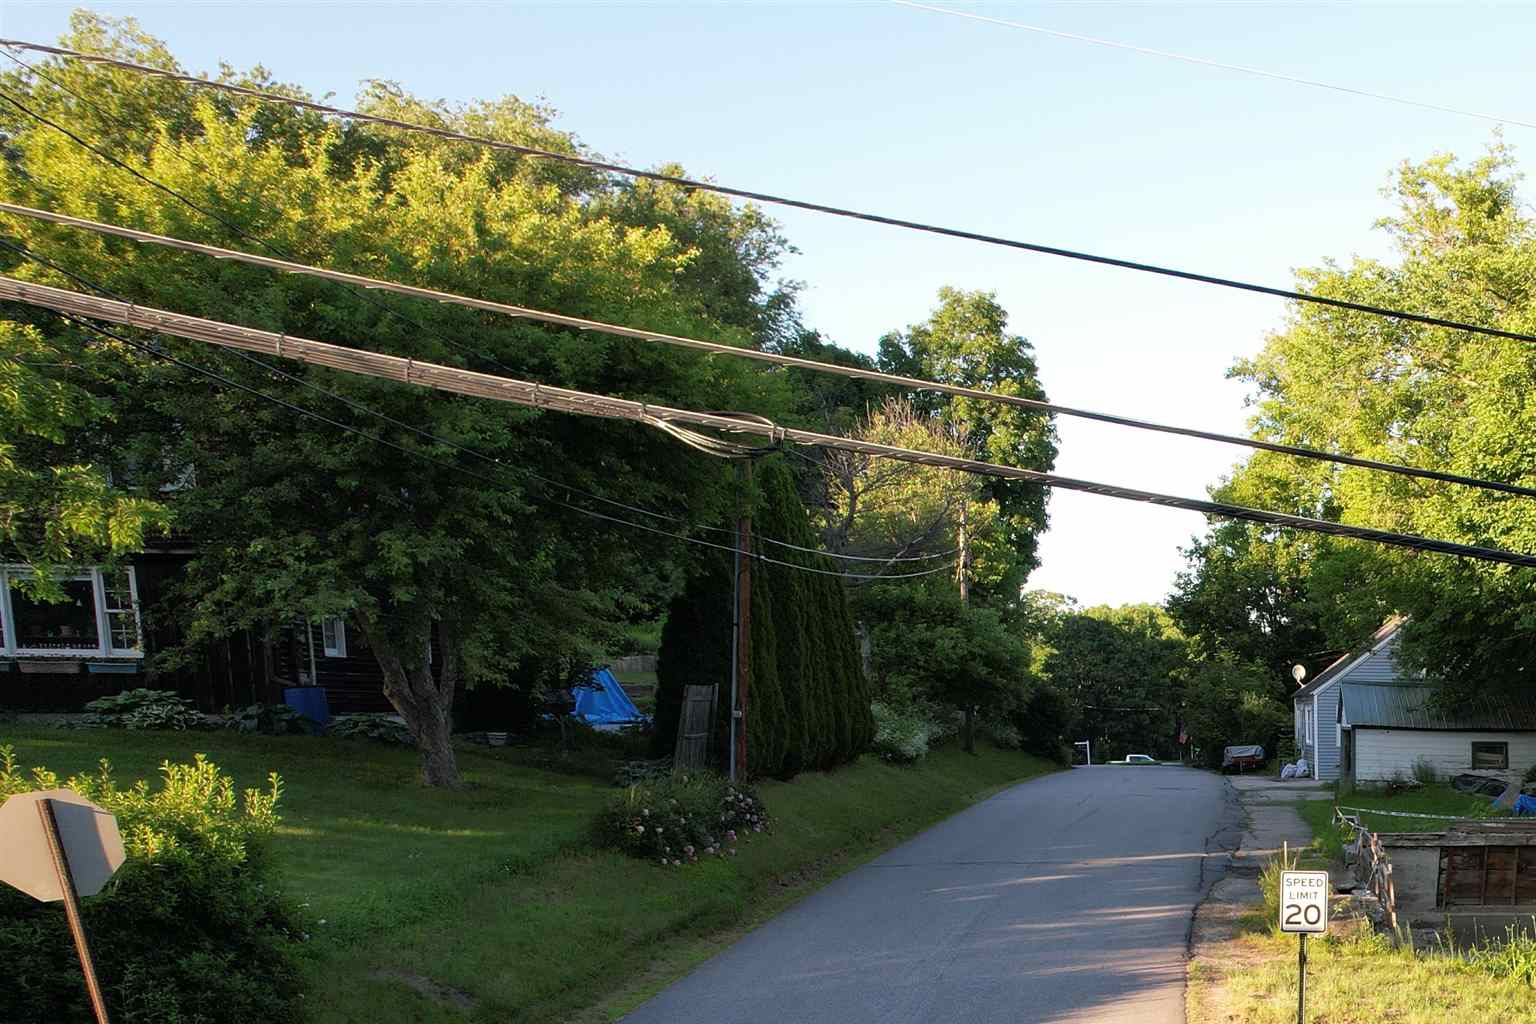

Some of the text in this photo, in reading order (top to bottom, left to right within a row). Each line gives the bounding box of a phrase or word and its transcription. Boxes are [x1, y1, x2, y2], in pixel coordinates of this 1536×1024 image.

[1286, 878, 1324, 887] SPEED
[1289, 891, 1319, 900] LIMIT
[1285, 904, 1321, 925] 20
